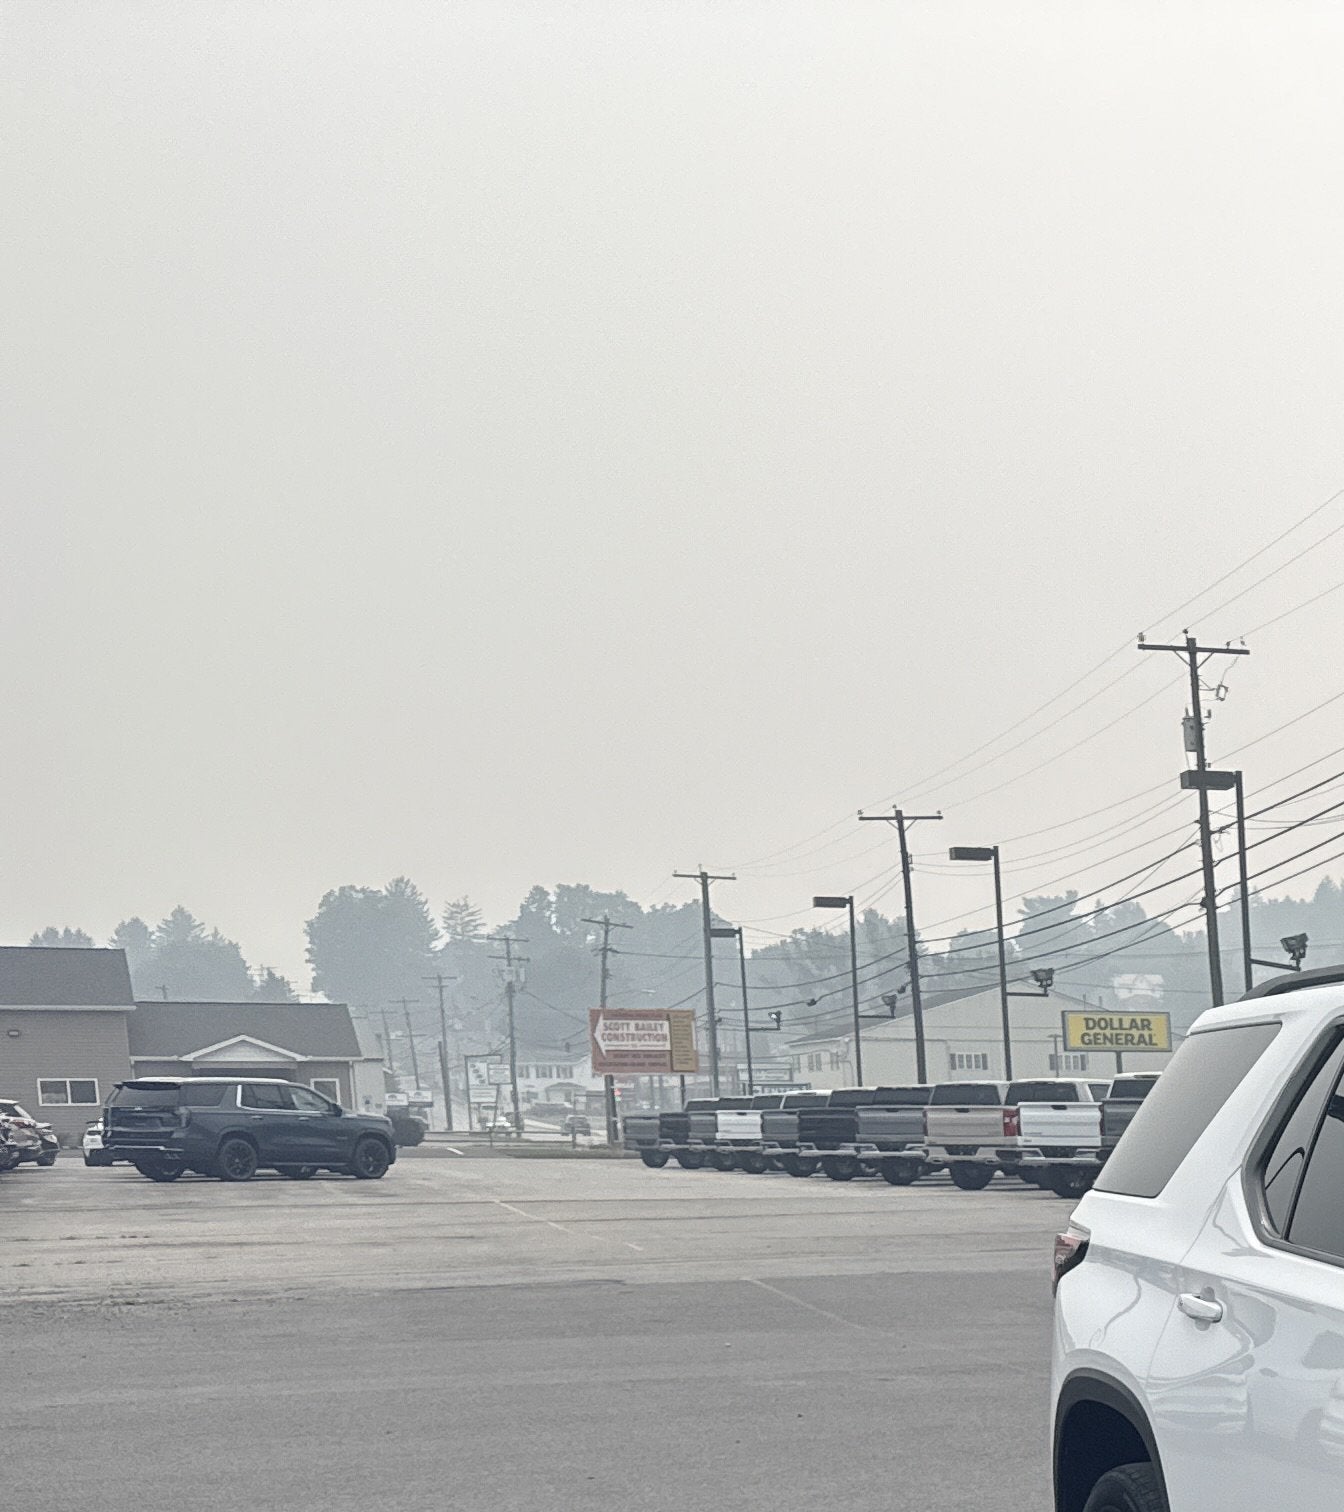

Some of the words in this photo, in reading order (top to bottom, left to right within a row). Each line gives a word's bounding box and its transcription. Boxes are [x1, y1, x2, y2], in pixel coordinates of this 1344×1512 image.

[603, 1022, 630, 1032] SCOTT
[1083, 1017, 1152, 1031] DOLLAR
[601, 1032, 668, 1042] CONSTRUCTION
[1080, 1032, 1158, 1046] GENERAL
